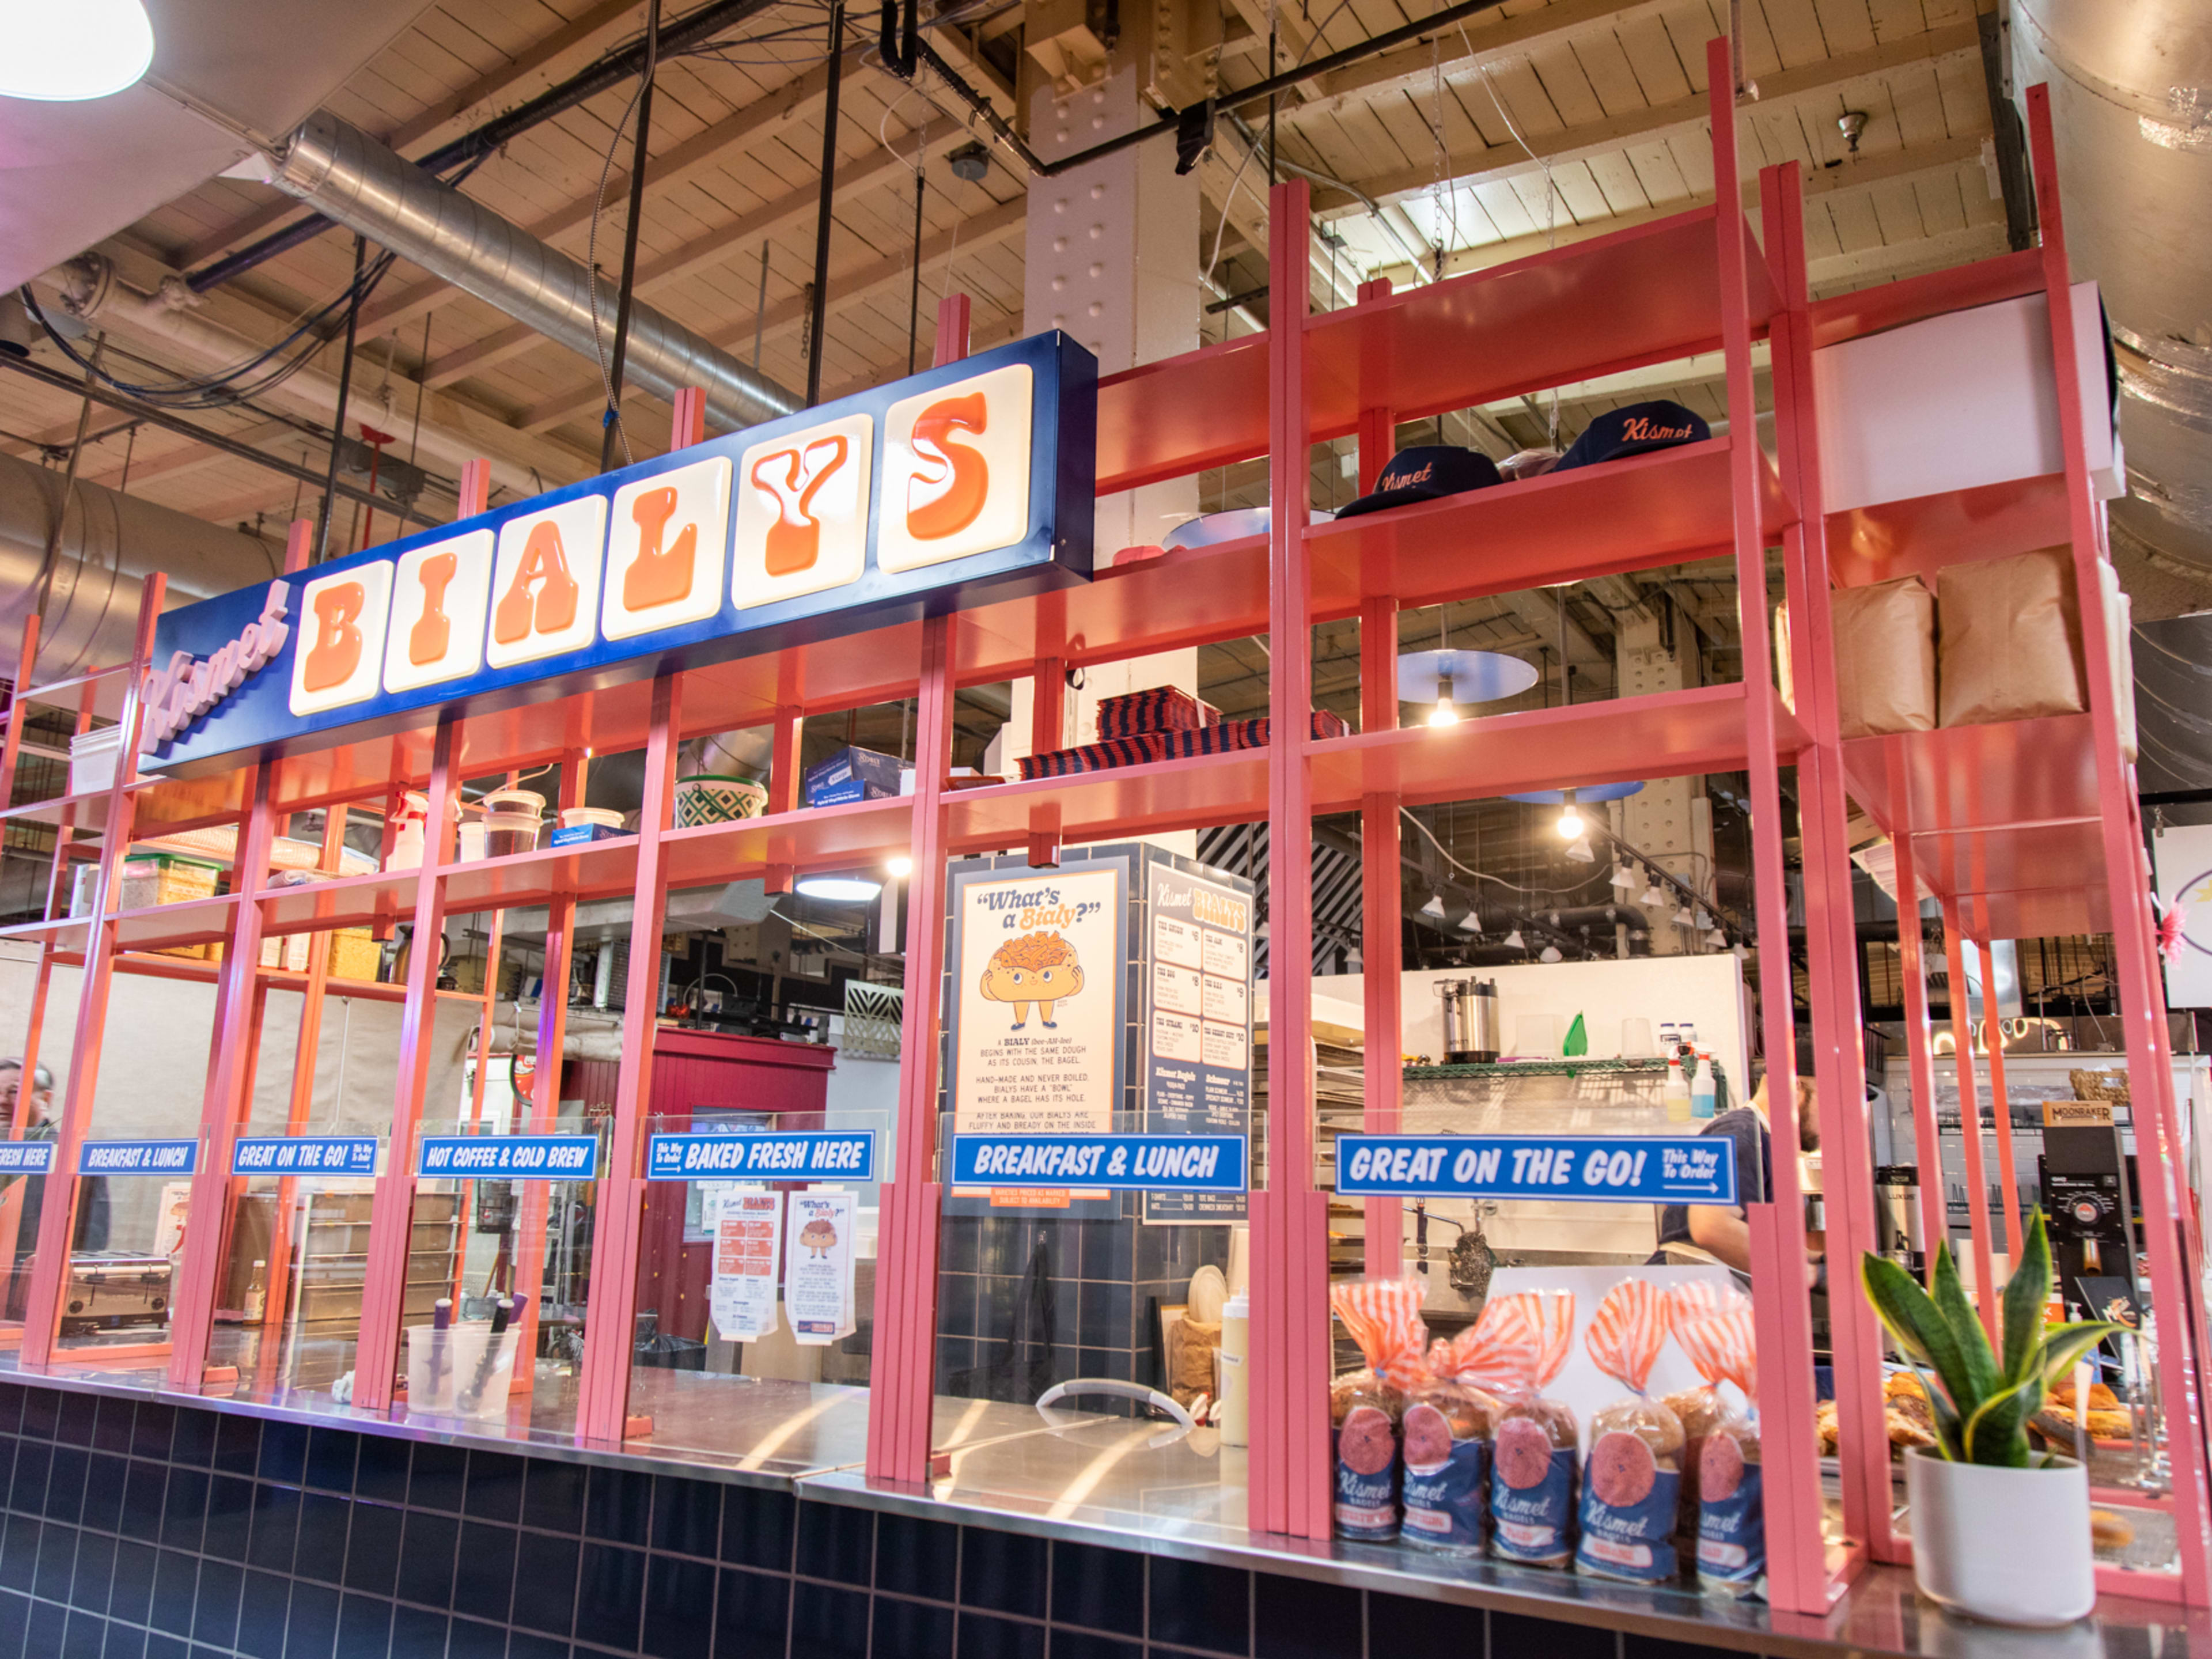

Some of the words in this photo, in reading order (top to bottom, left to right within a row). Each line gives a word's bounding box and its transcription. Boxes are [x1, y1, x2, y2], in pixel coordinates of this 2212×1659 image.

[1622, 417, 1693, 442] Kismet
[1382, 463, 1433, 491] Kismet
[138, 578, 290, 753] Kismet
[304, 392, 990, 692] BIALYS
[977, 887, 1060, 911] “What’s
[1157, 882, 1192, 907] Kismet
[1193, 888, 1247, 934] BIALYS
[1003, 914, 1016, 929] a
[1019, 902, 1101, 930] Bialy?”
[980, 1049, 1003, 1057] BEGINS
[1040, 1047, 1059, 1055] SAME
[1004, 1038, 1030, 1046] BIALY
[976, 1075, 1017, 1084] HAND-MADE
[994, 1085, 1017, 1093] BIALYS
[1074, 1120, 1096, 1128] INSIDE
[2052, 1107, 2111, 1120] MOONRAKER
[22, 1147, 49, 1166] HERE
[88, 1147, 143, 1168] BREAKFAST
[142, 1149, 151, 1167] &
[153, 1146, 188, 1166] LUNCH
[238, 1145, 277, 1166] GREAT
[276, 1145, 297, 1166] ON
[298, 1144, 323, 1166] THE
[324, 1145, 349, 1166] GO!
[426, 1146, 453, 1167] HOT
[452, 1147, 499, 1167] COFFEE
[498, 1147, 510, 1167] &
[512, 1146, 546, 1167] COLD
[547, 1146, 589, 1168] BREW
[656, 1143, 669, 1153] This
[670, 1143, 684, 1154] Way
[663, 1153, 681, 1163] Order
[685, 1142, 745, 1170] BAKED
[747, 1141, 809, 1169] FRESH
[810, 1140, 865, 1169] HERE
[1662, 1149, 1688, 1164] This
[1692, 1150, 1719, 1167] Way
[974, 1144, 1105, 1176] BREAKFAST
[1107, 1145, 1127, 1176] &
[1133, 1145, 1219, 1177] LUNCH
[1349, 1147, 1449, 1184] GREAT
[1453, 1148, 1502, 1184] ON
[1512, 1148, 1575, 1185] THE
[1583, 1149, 1647, 1187] GO!
[1662, 1164, 1677, 1178] To
[1679, 1164, 1716, 1179] Order
[1339, 1470, 1391, 1499] Kismet
[1494, 1483, 1551, 1517] Kismet
[1586, 1499, 1648, 1537] Kismet
